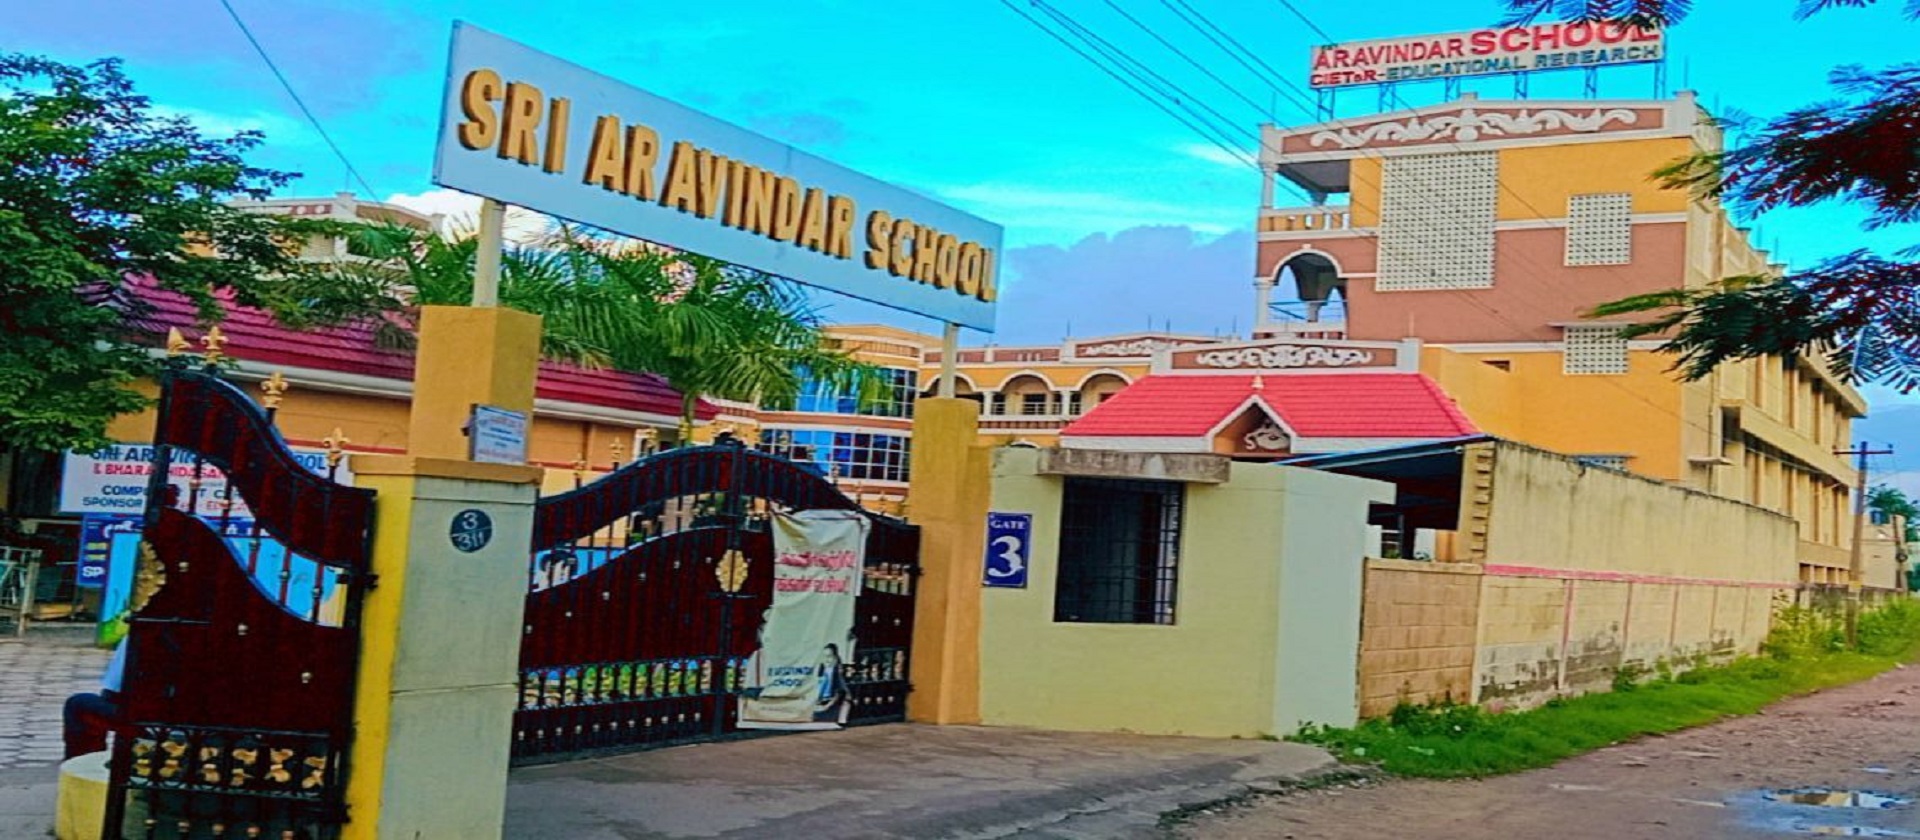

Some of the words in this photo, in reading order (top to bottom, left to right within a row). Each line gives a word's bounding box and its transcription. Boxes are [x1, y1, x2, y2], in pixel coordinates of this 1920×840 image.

[1313, 38, 1463, 70] ARAVINDAR
[1471, 18, 1659, 56] SCHOOL
[1535, 45, 1659, 68] RESEARCH
[458, 69, 570, 174] SRI
[582, 114, 855, 259] ARAVINDAR
[864, 210, 997, 302] SCHOOL
[462, 512, 478, 530] 3
[989, 520, 1026, 530] GATE
[987, 535, 1025, 577] 3
